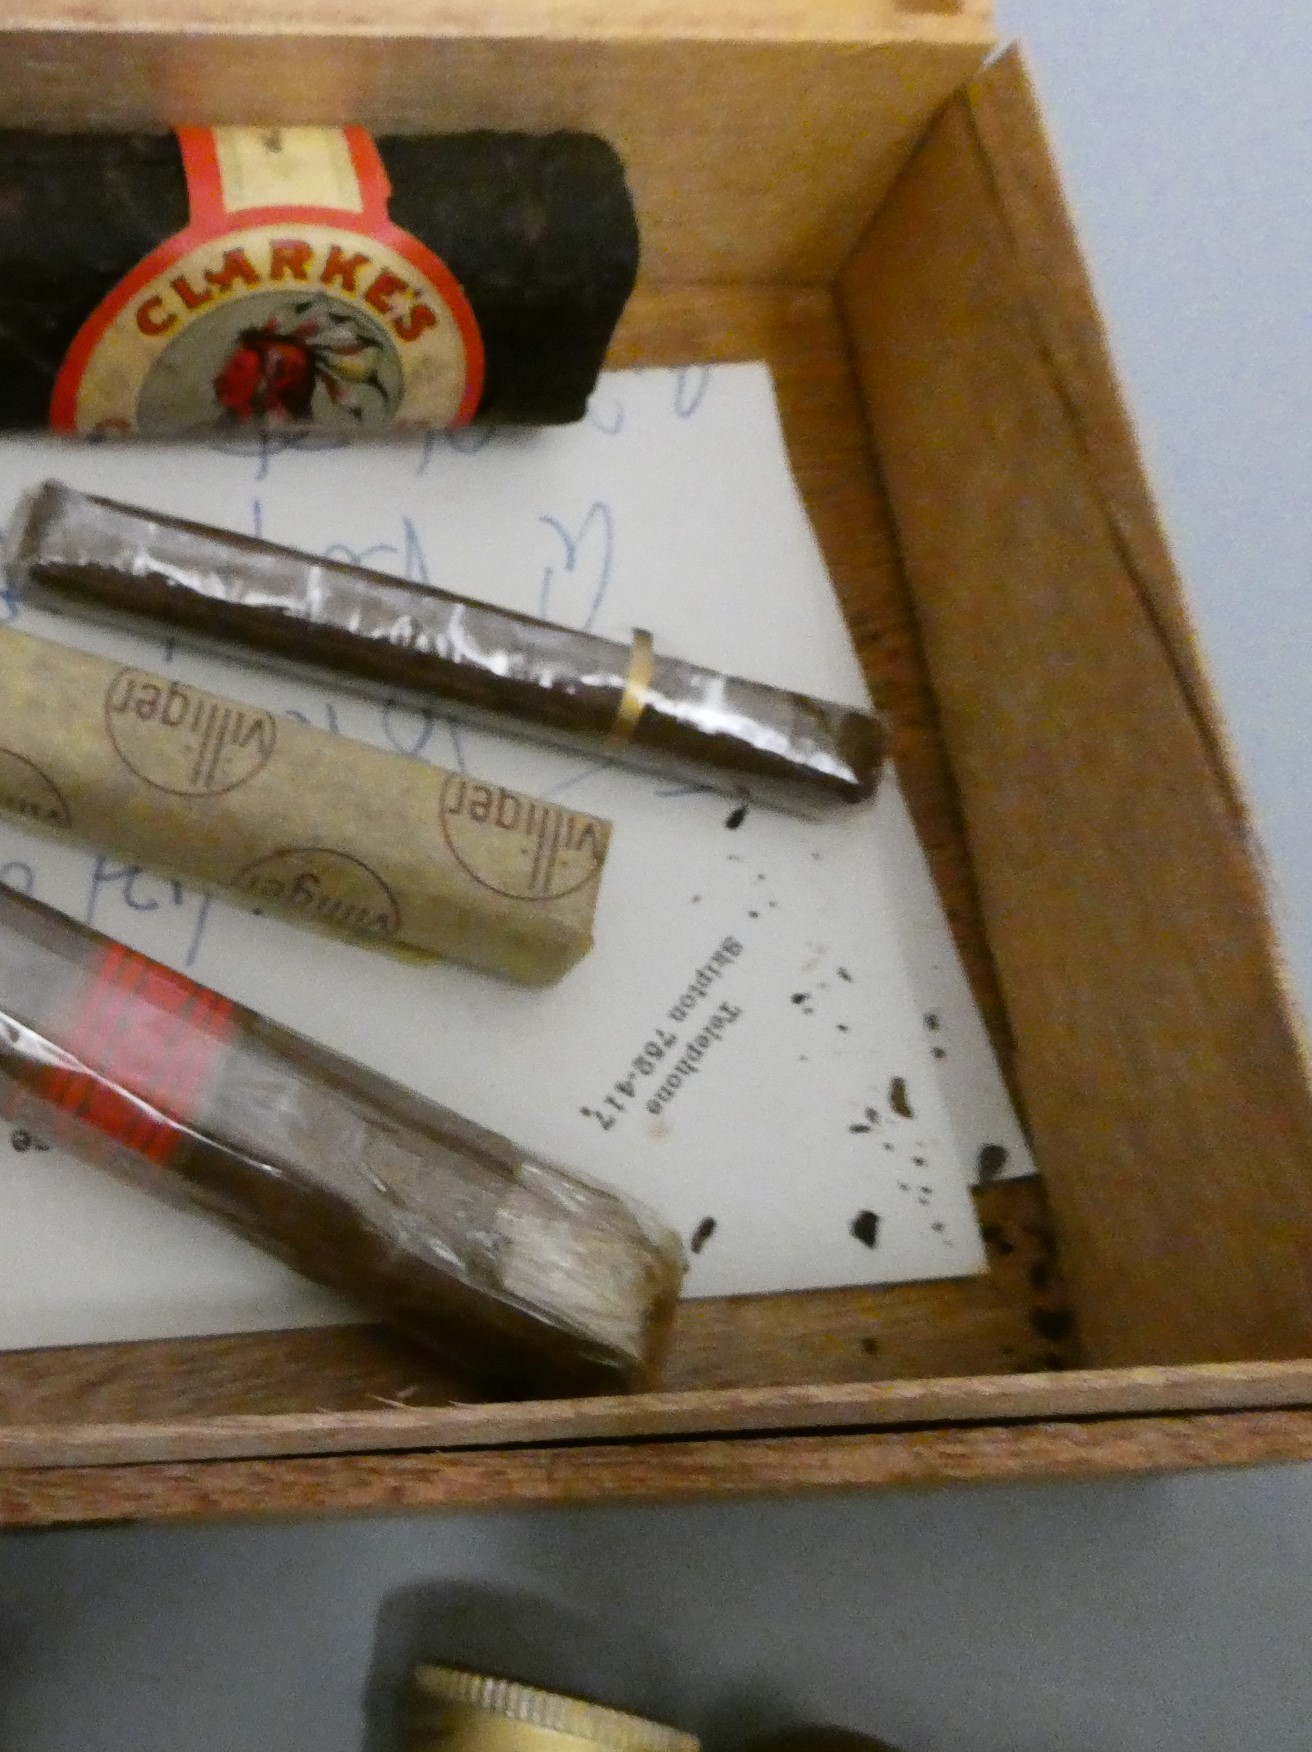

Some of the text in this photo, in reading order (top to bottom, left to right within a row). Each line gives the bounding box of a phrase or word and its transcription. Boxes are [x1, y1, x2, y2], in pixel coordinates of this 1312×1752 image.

[134, 238, 439, 343] CLARKE'S
[667, 936, 744, 1022] Skipton
[646, 1001, 742, 1115] Telephone
